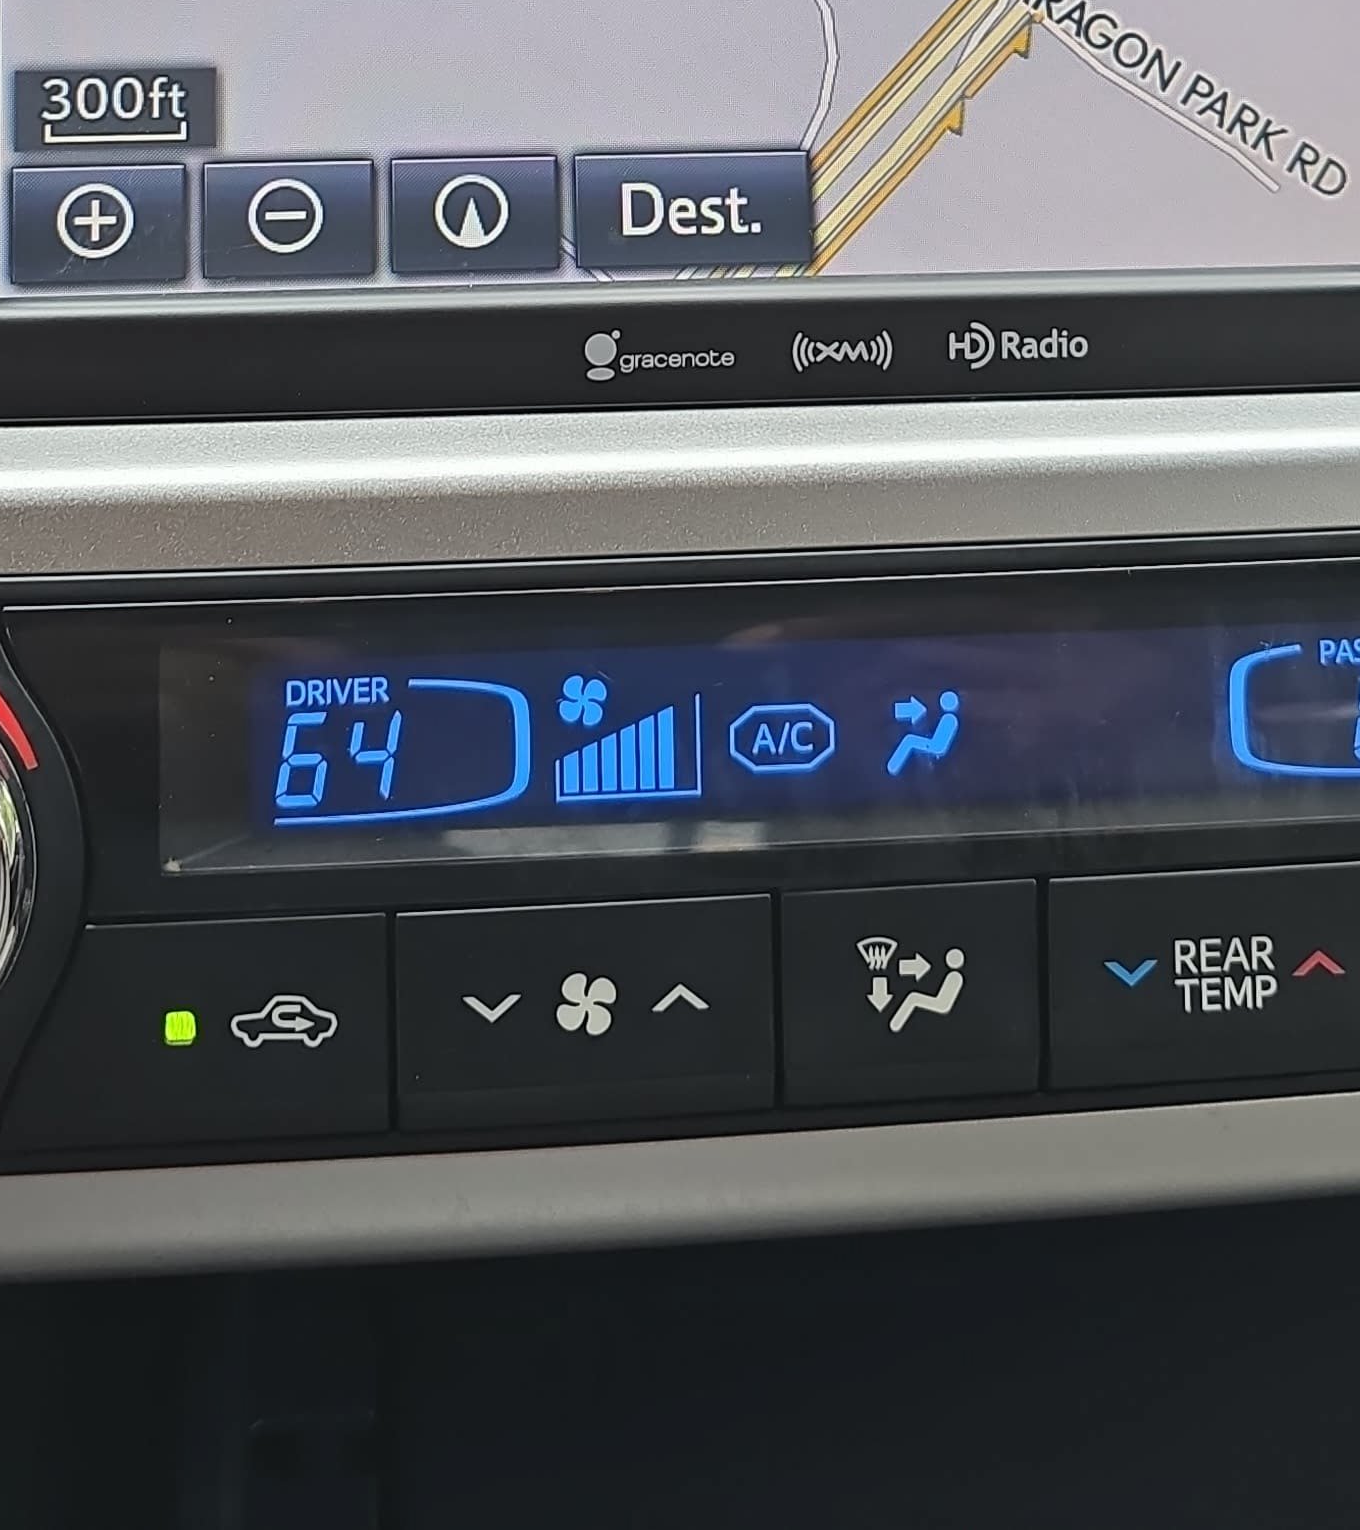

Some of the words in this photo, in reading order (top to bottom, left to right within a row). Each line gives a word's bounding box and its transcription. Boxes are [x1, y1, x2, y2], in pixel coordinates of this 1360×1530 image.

[41, 76, 187, 122] 300ft
[1182, 72, 1295, 161] PARK
[1285, 141, 1347, 198] RD
[621, 182, 762, 237] Dest.
[619, 348, 735, 373] gracenote
[1001, 328, 1088, 360] Radio
[285, 676, 390, 708] DRIVER
[752, 720, 815, 756] A/C
[275, 710, 402, 809] 64
[1174, 935, 1274, 972] REAR
[1175, 975, 1277, 1012] TEMP
